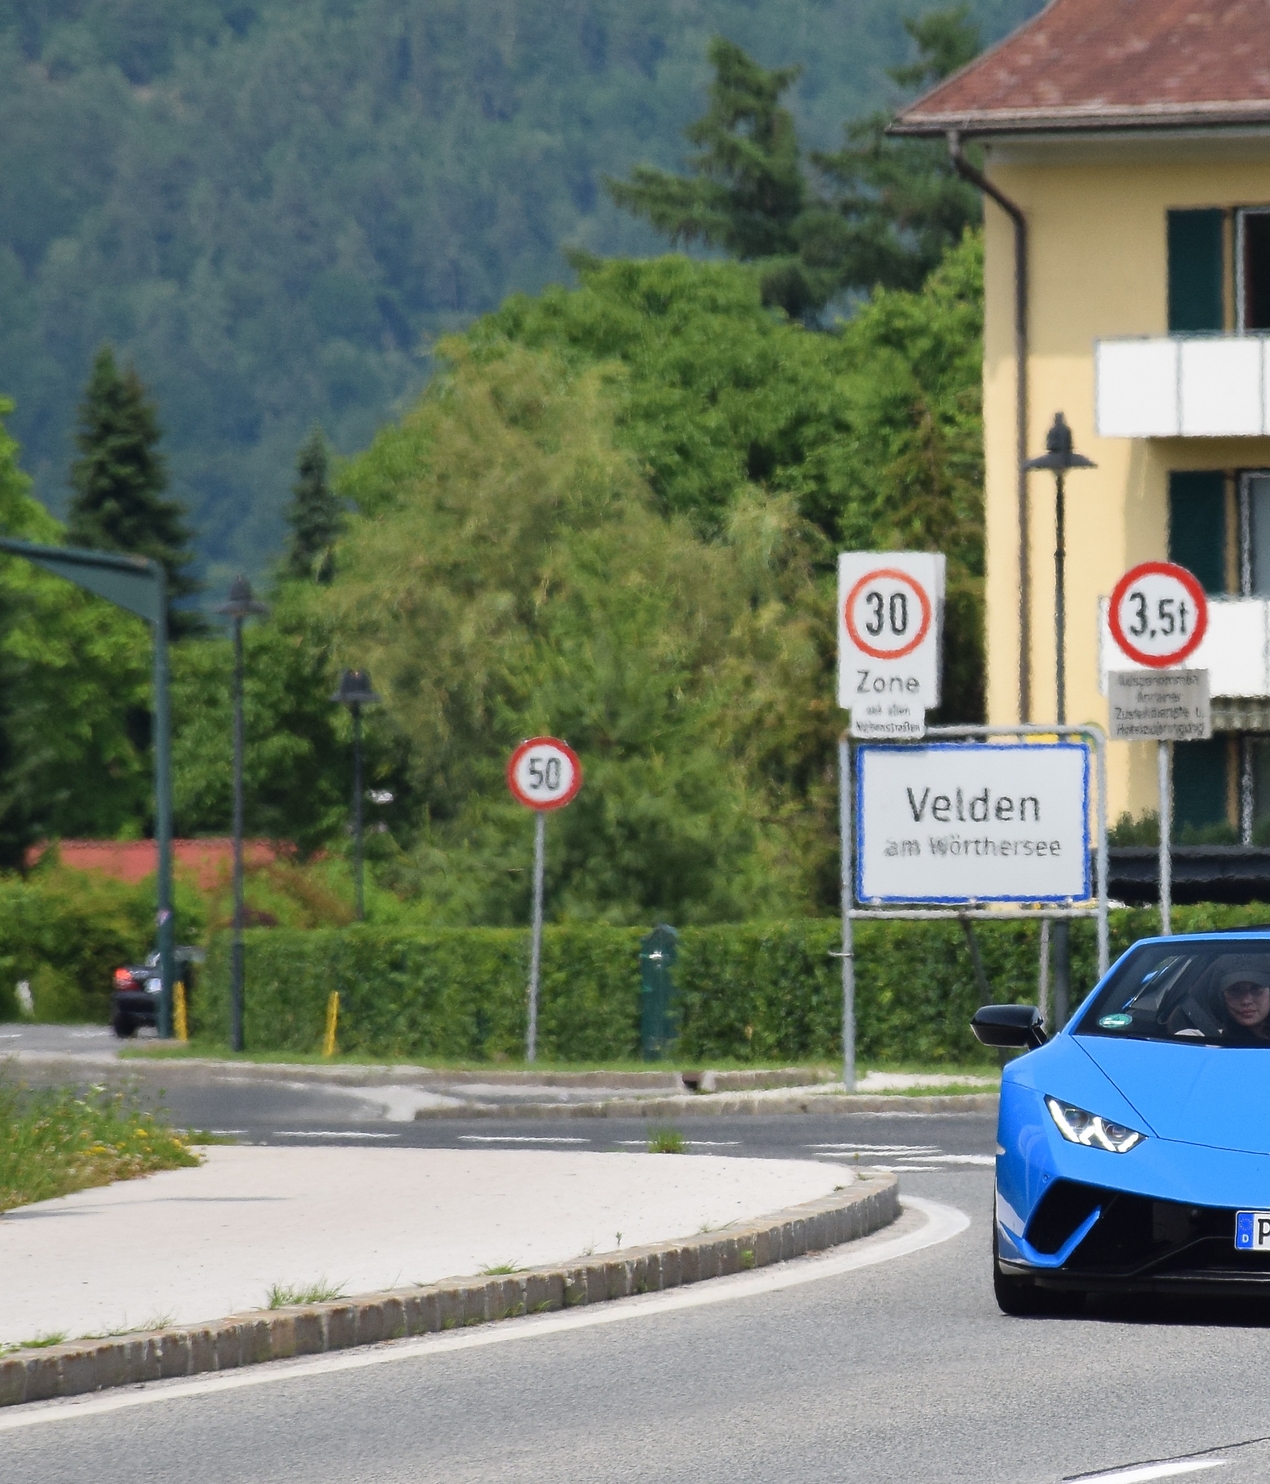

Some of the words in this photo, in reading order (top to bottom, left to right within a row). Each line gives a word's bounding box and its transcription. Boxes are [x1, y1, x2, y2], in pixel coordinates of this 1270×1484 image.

[865, 592, 908, 635] 30
[1129, 591, 1188, 637] 3,5t
[857, 669, 920, 693] Zone
[529, 758, 561, 791] 50
[906, 787, 1041, 822] Velden
[884, 837, 921, 857] am
[928, 834, 1061, 857] Wörthersee
[1242, 1234, 1250, 1243] D
